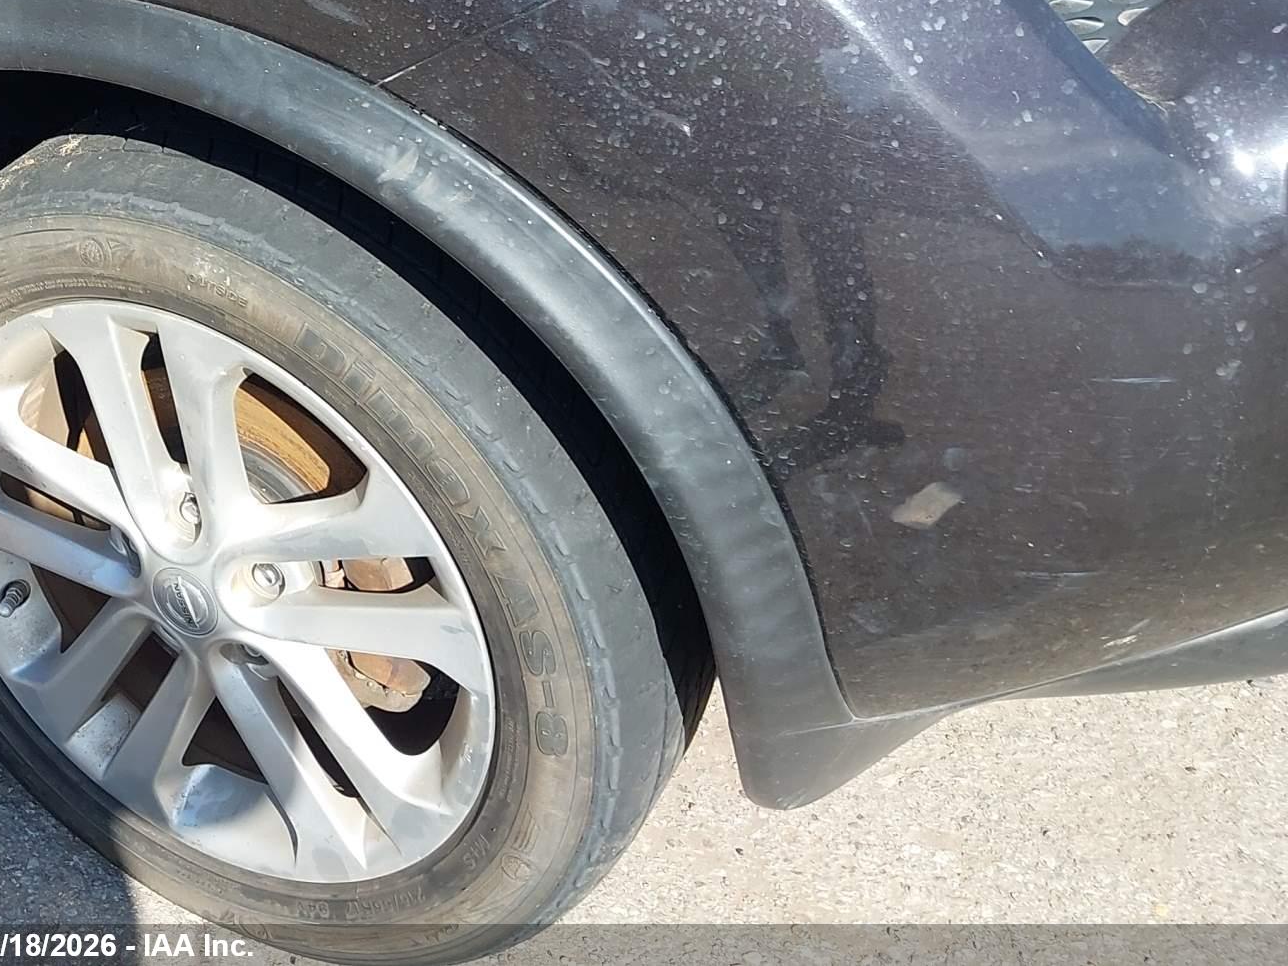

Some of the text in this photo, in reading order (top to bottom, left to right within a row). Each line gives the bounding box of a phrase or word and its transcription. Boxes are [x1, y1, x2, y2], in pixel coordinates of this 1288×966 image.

[172, 581, 195, 626] NISSAN
[294, 322, 507, 556] Dimax
[493, 574, 568, 757] AS-8
